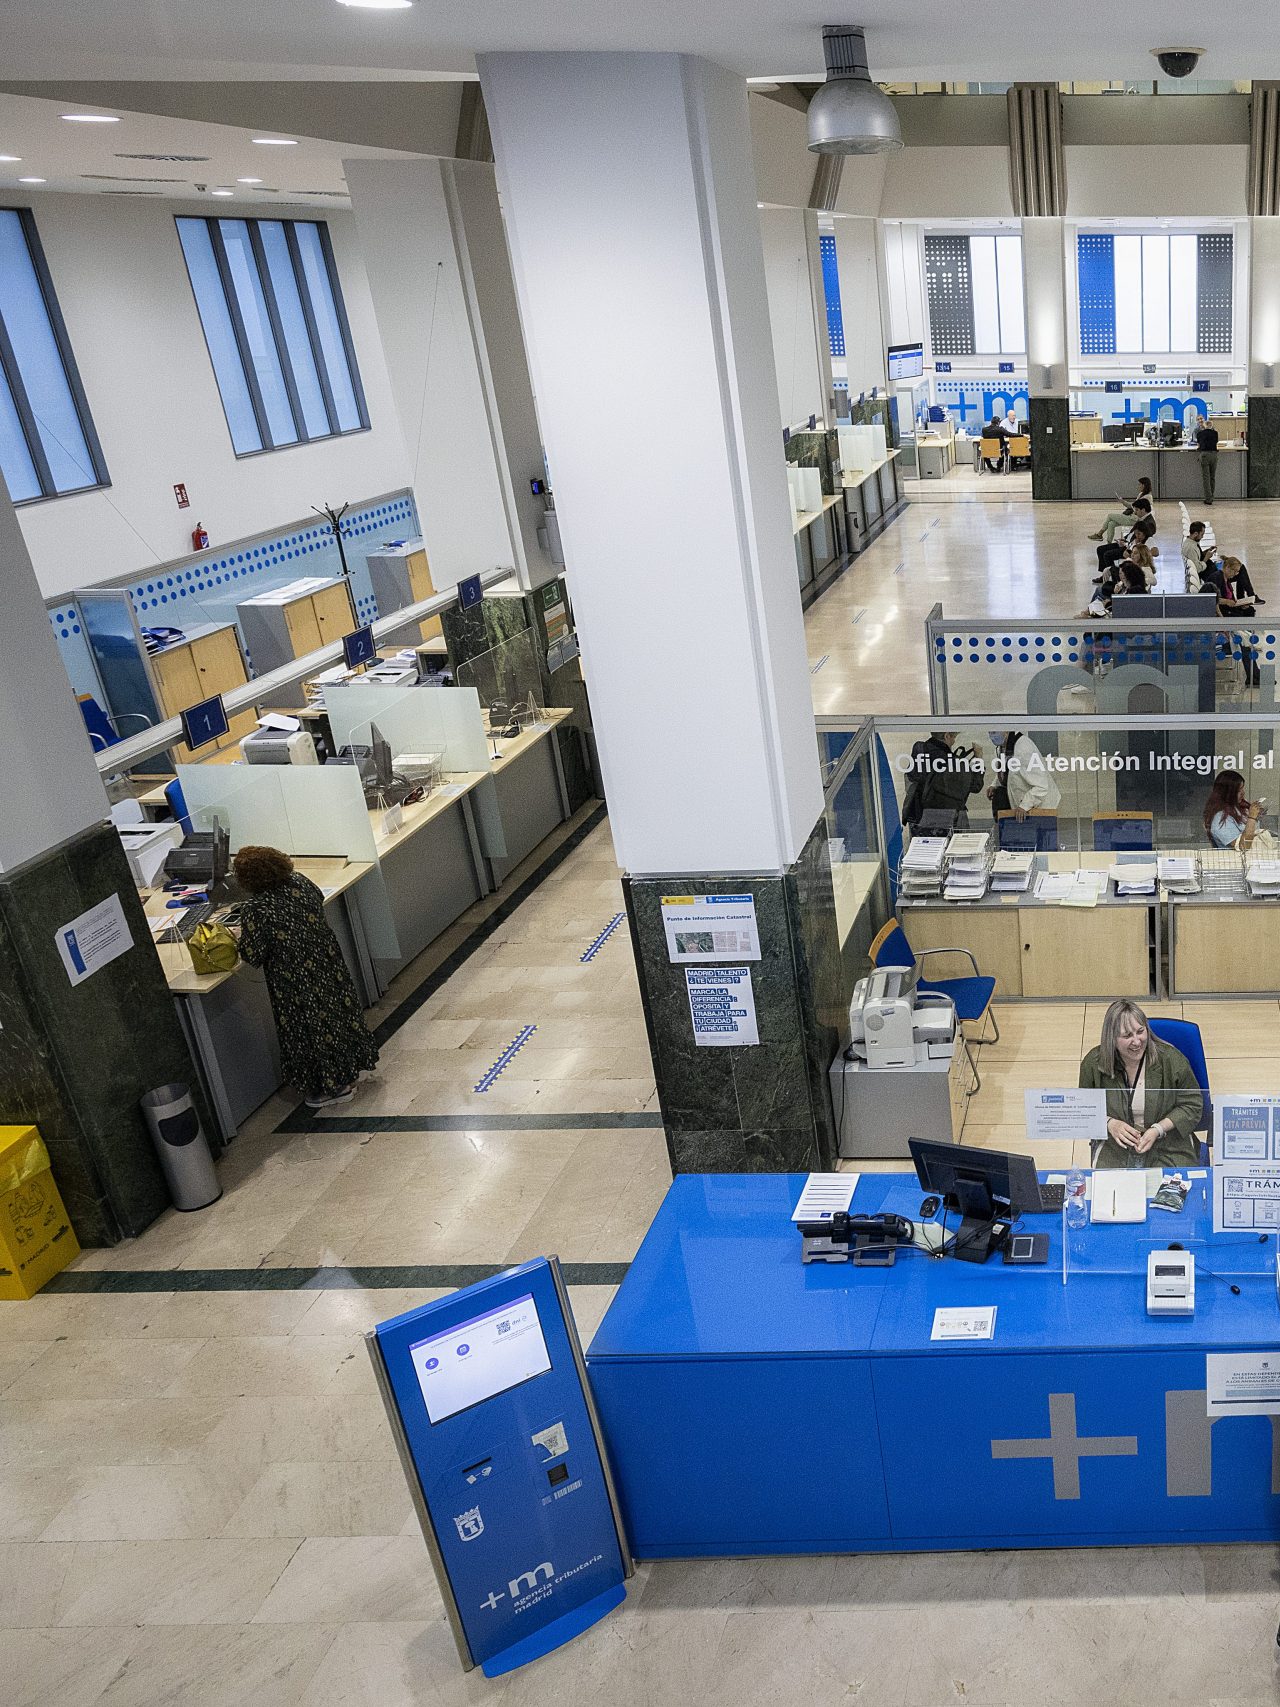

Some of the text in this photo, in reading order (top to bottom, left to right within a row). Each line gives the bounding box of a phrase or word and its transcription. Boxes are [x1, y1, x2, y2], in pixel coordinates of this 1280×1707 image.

[469, 586, 476, 600] 3
[357, 641, 365, 657] 2
[203, 714, 213, 732] 1
[895, 752, 984, 774] Oficina
[991, 752, 1021, 772] de
[1026, 750, 1140, 772] Atención
[1149, 750, 1244, 775] Integral
[1252, 749, 1273, 770] al
[1232, 1108, 1258, 1116] TRÁMITES
[1224, 1120, 1266, 1129] CITA PREVIA
[479, 1561, 555, 1610] +m
[513, 1554, 603, 1608] agencia tributaria
[514, 1588, 553, 1615] madrid
